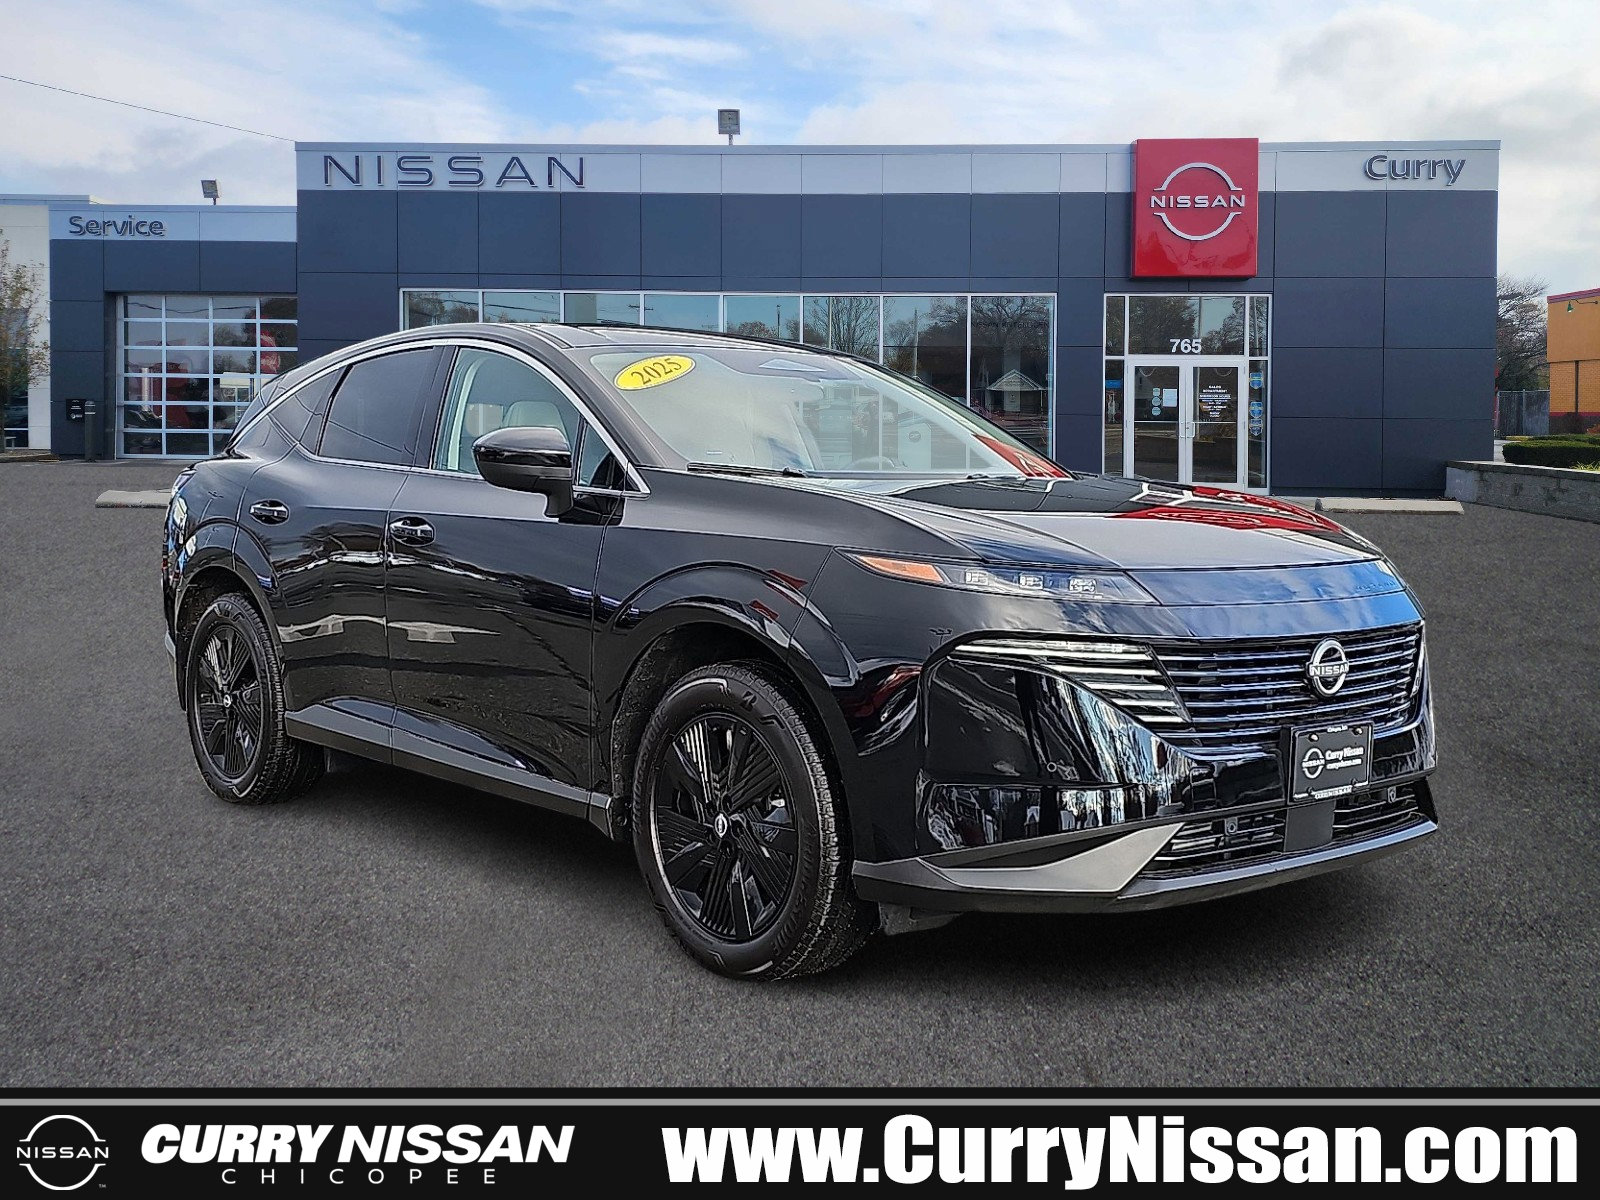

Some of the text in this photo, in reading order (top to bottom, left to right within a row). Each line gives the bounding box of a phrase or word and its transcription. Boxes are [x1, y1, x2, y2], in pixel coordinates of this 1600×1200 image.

[324, 155, 585, 188] NISSAN
[1364, 154, 1466, 186] Curry
[1150, 194, 1246, 209] NISSAN
[69, 215, 165, 236] Service
[1169, 338, 1202, 353] 765
[631, 358, 682, 385] 2025
[1310, 663, 1349, 676] NISSAN
